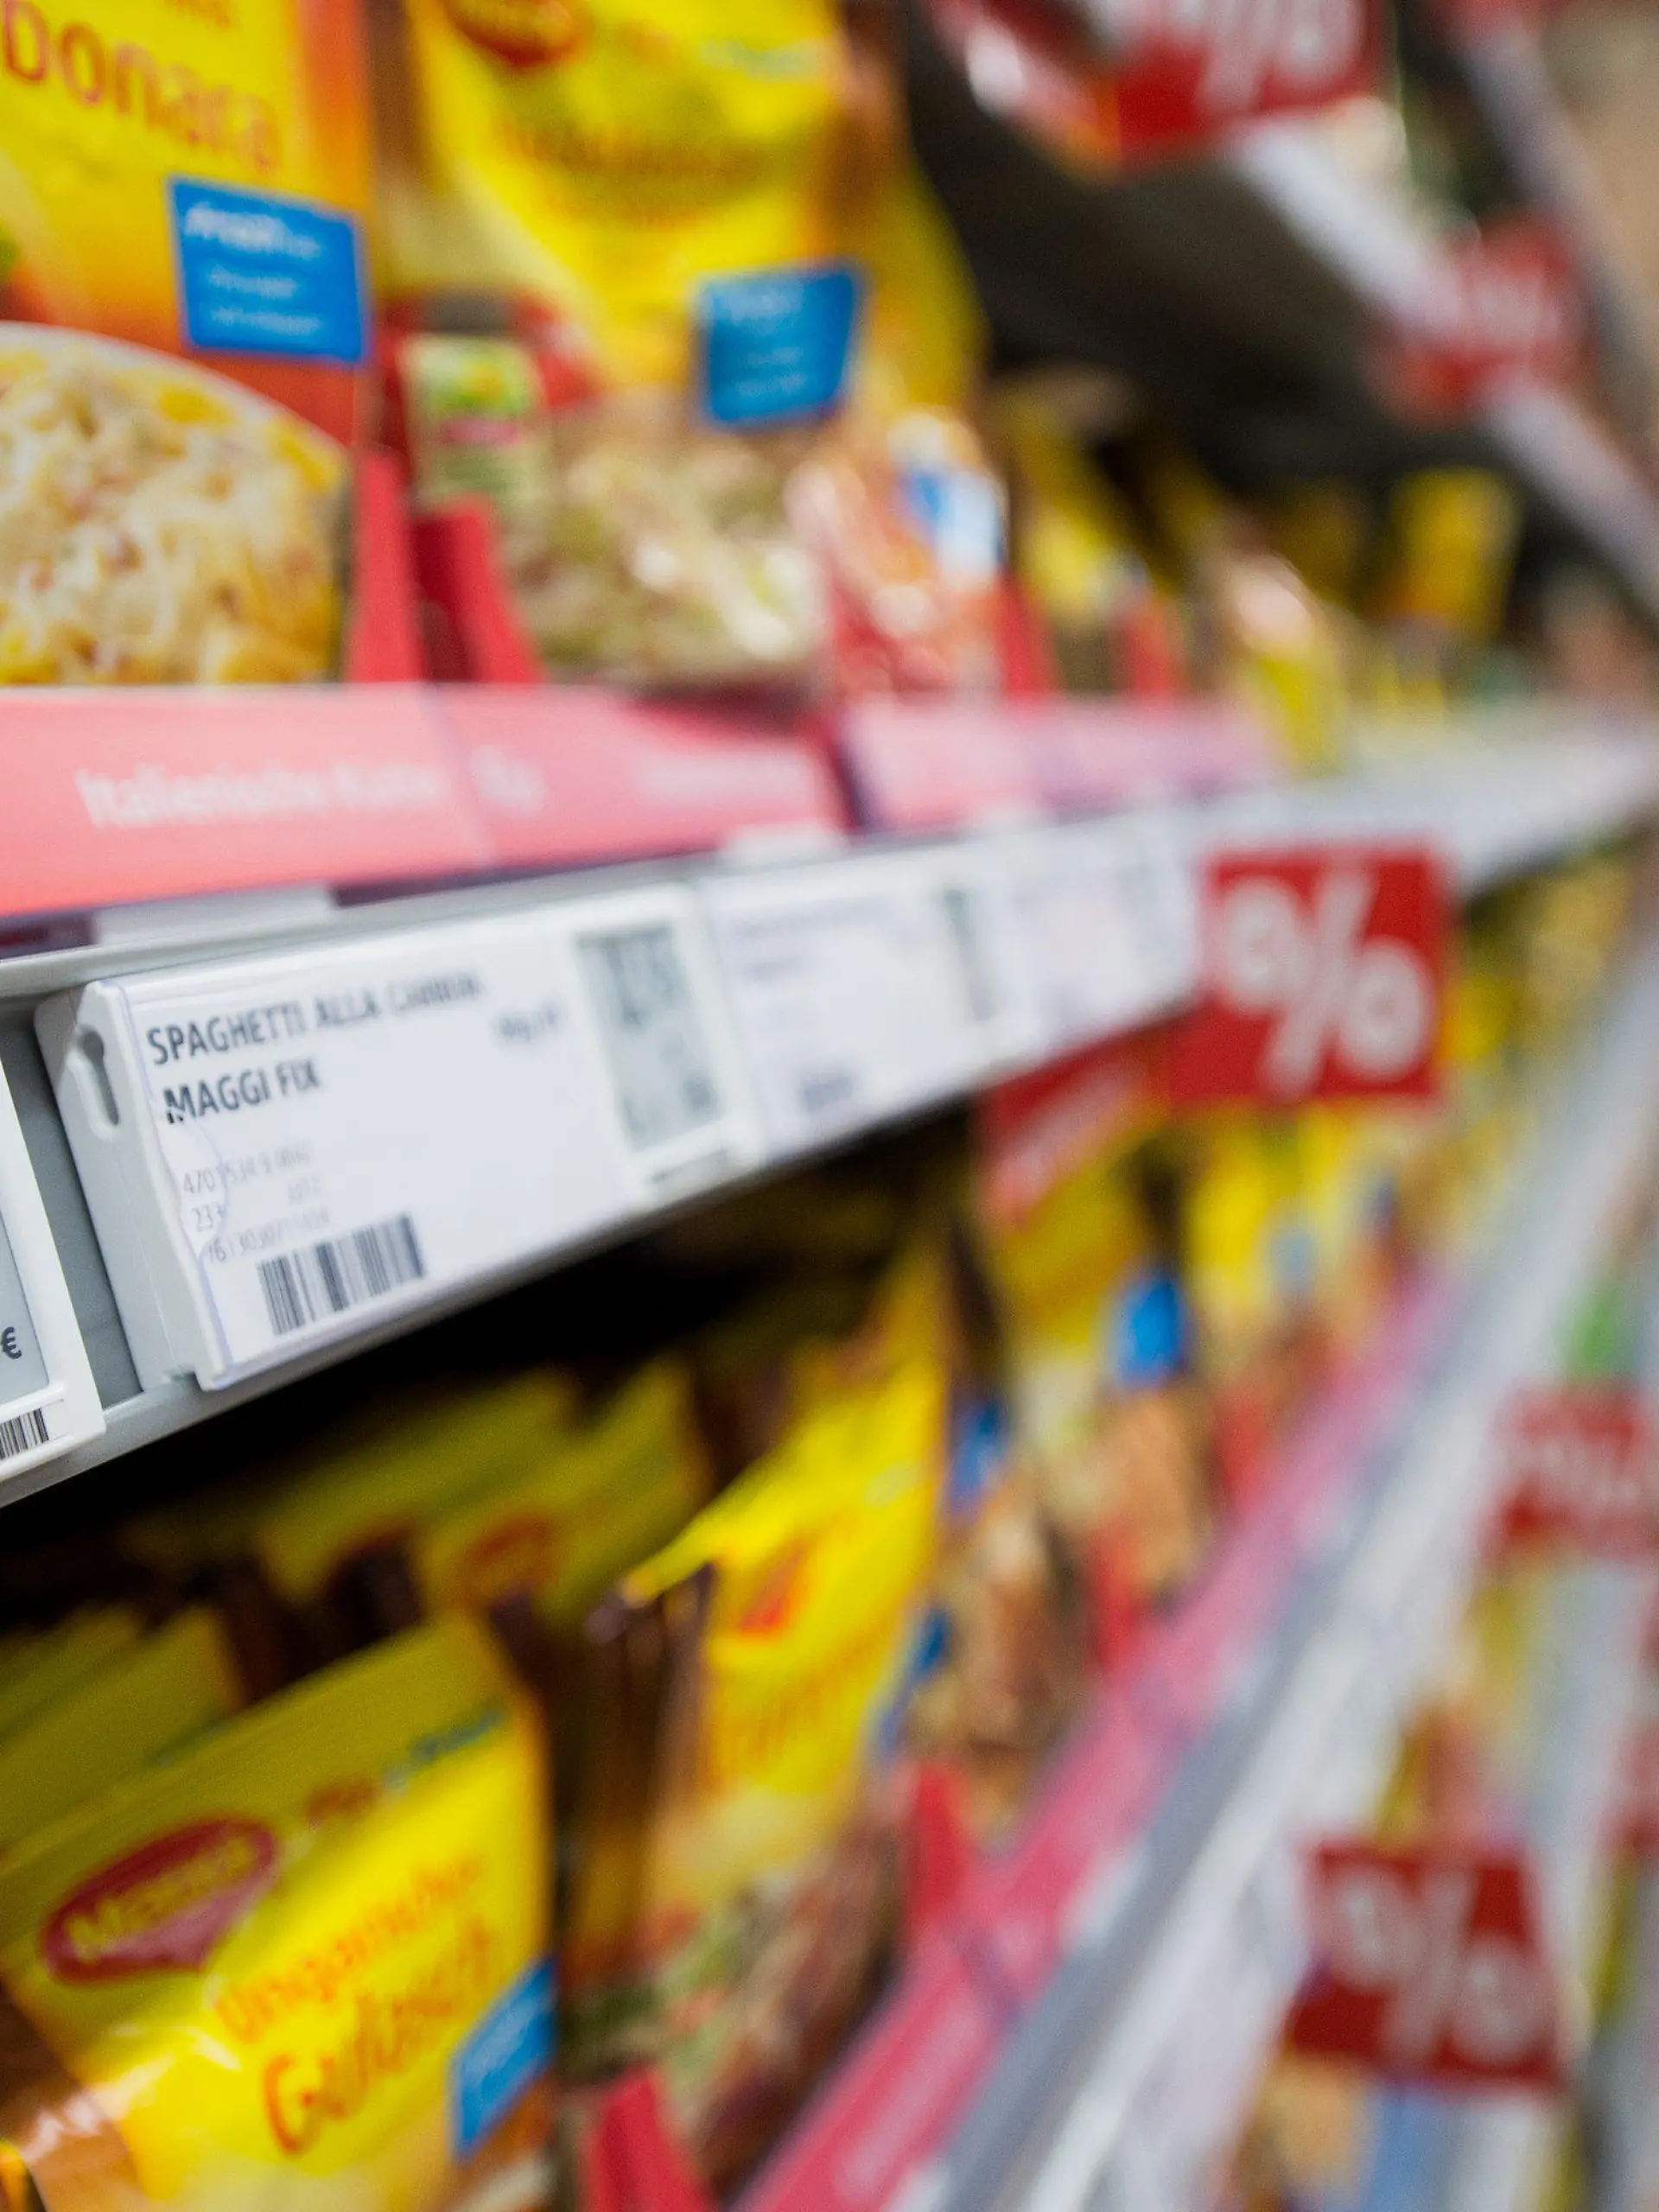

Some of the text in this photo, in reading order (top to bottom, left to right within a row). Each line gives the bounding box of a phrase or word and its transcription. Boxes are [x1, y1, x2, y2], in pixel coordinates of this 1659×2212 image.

[146, 998, 307, 1066] SPAGHETTI
[162, 1054, 322, 1125] MAGGI FIX
[0, 1326, 22, 1360] €
